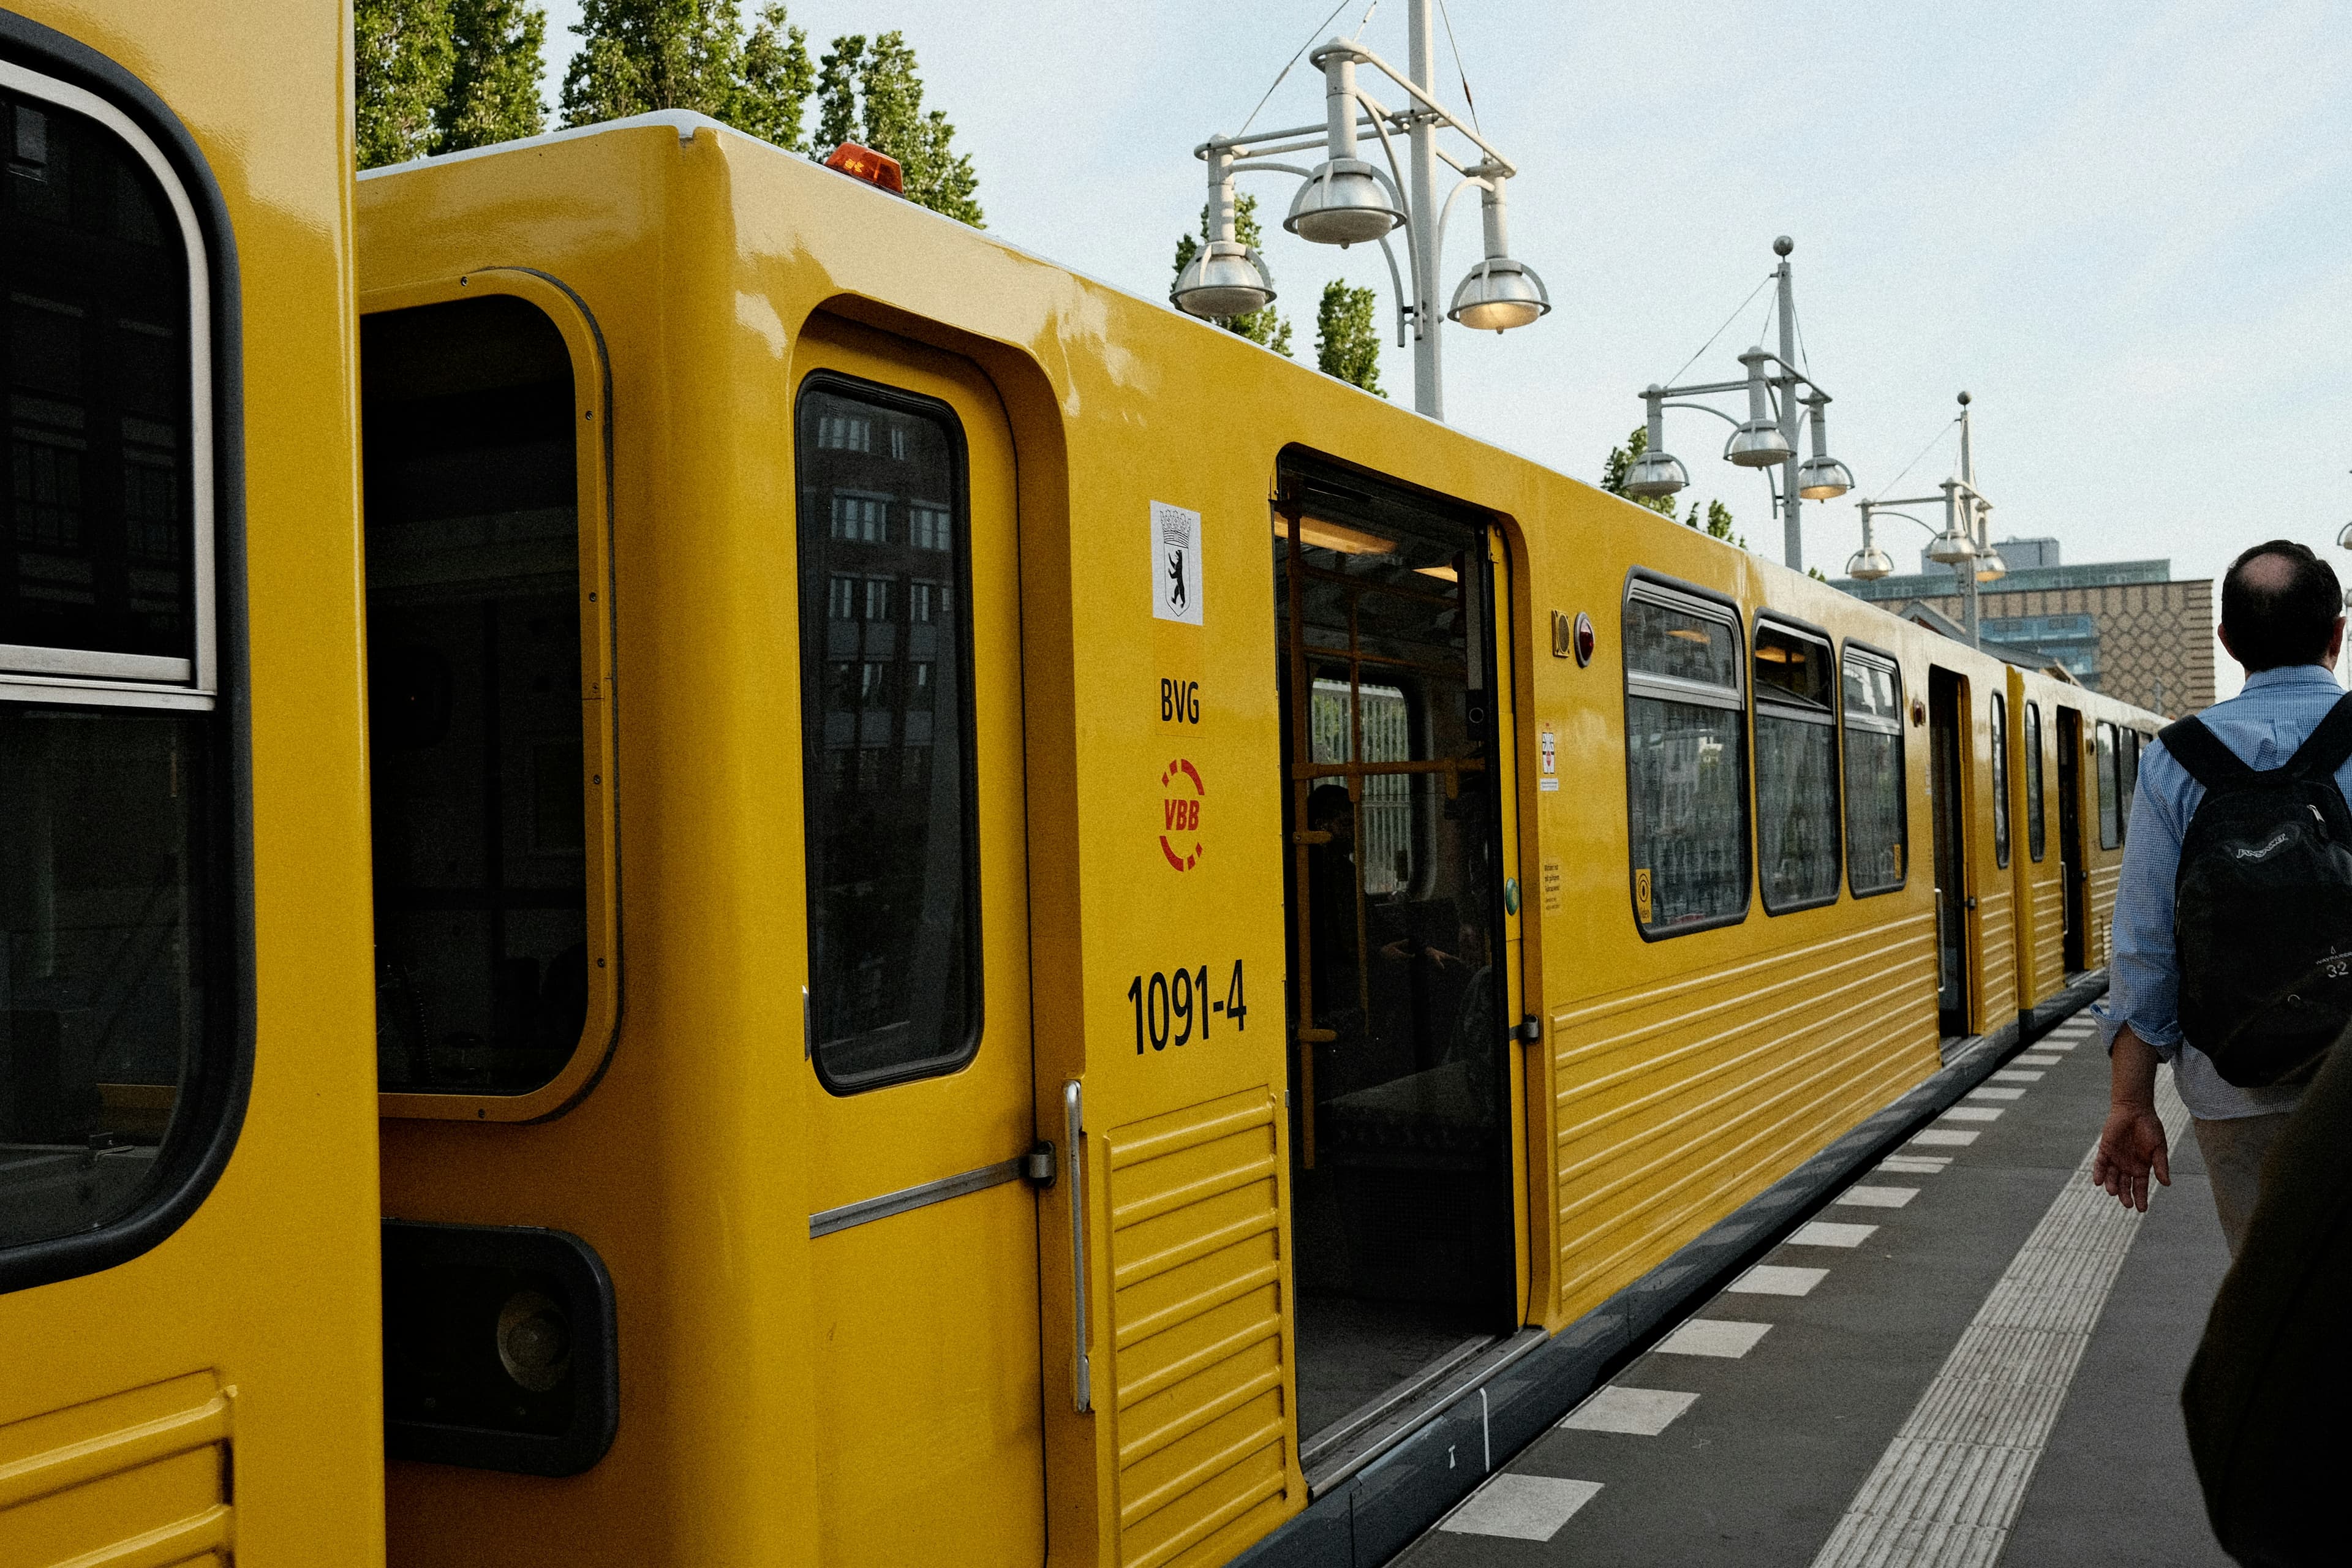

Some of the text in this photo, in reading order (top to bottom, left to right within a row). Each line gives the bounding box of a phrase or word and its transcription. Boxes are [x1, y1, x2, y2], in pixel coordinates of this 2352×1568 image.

[1161, 677, 1199, 725] BVG
[1164, 799, 1200, 831] VBB
[2326, 961, 2349, 978] 32
[1128, 959, 1247, 1055] 1091-4
